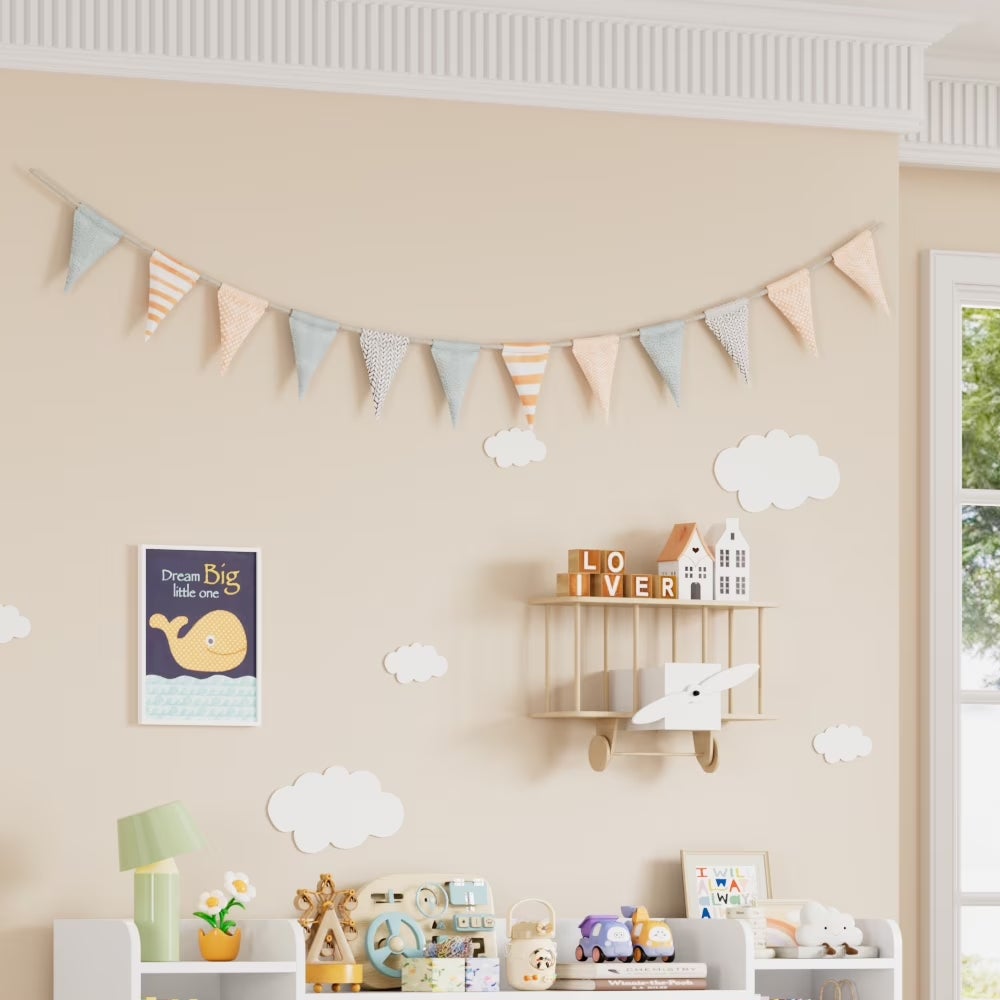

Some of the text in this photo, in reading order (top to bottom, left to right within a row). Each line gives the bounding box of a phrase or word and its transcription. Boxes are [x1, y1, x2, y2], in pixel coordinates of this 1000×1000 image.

[161, 563, 241, 595] Dream Big
[173, 583, 220, 599] little one
[696, 867, 708, 878] I
